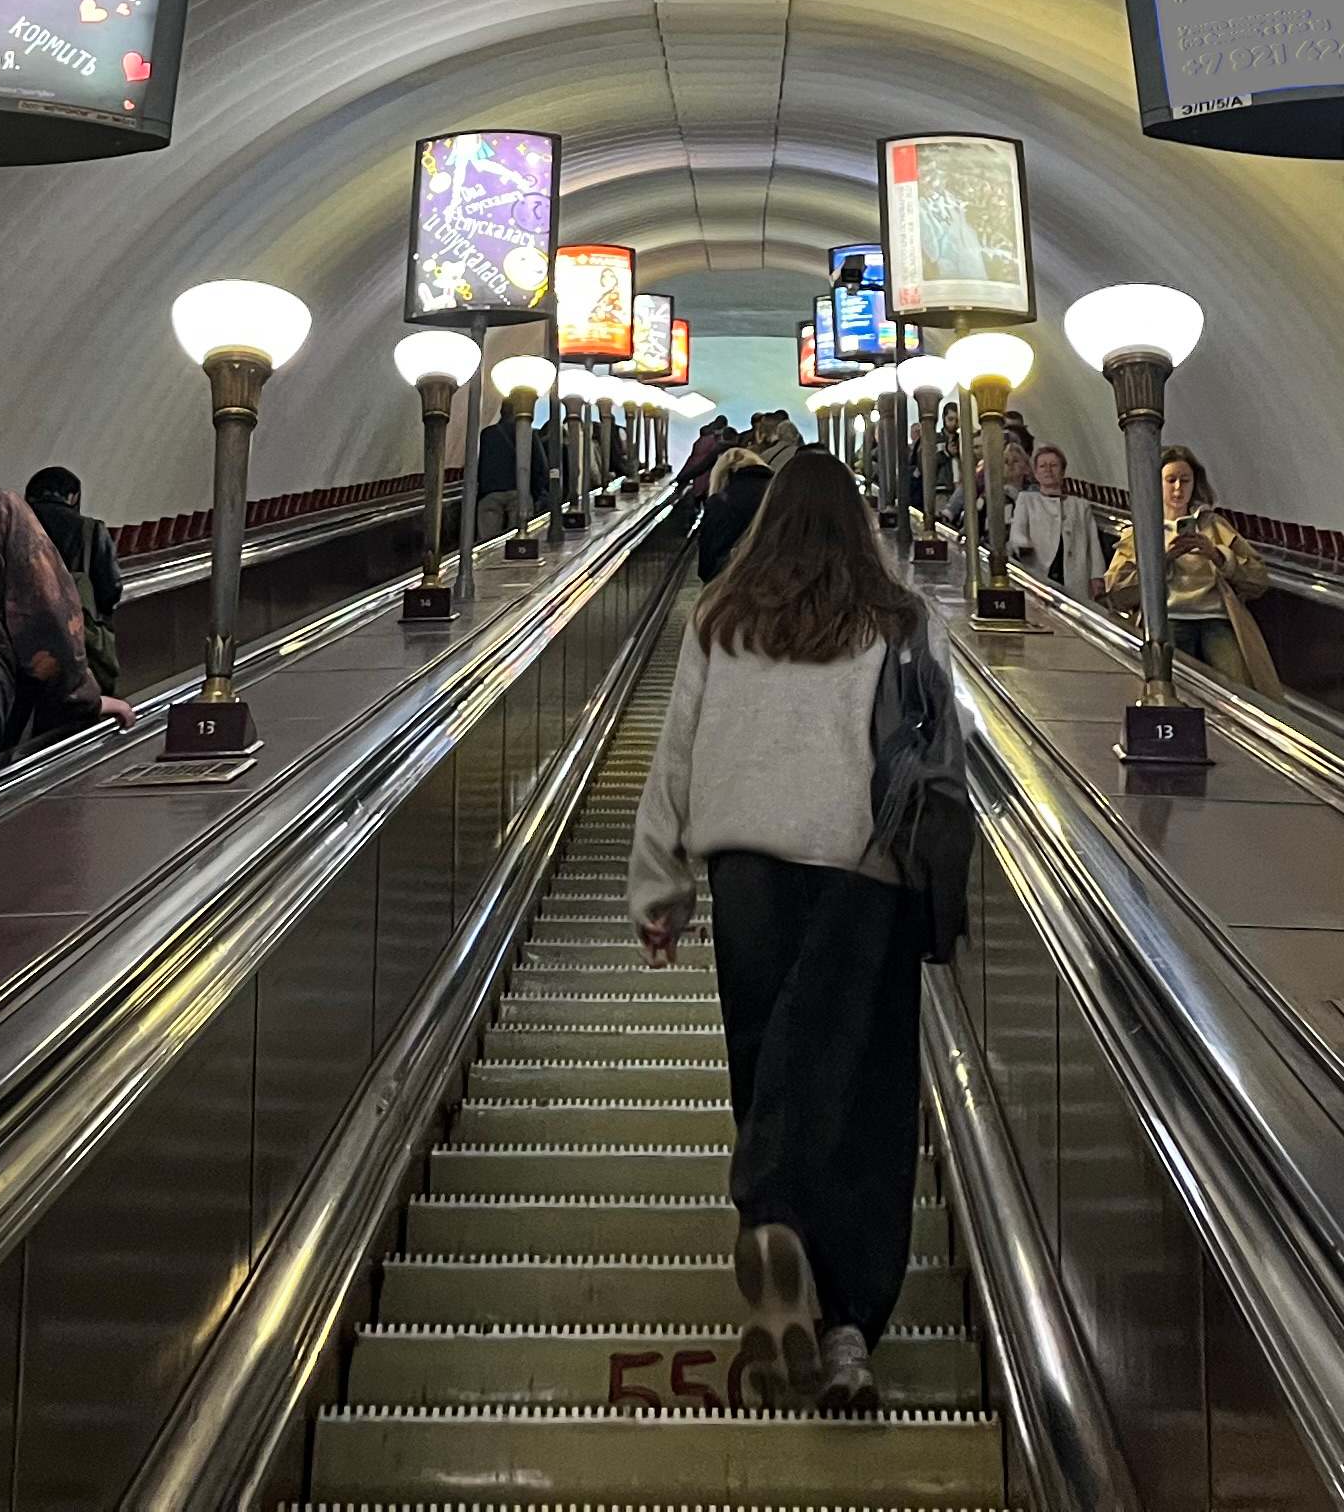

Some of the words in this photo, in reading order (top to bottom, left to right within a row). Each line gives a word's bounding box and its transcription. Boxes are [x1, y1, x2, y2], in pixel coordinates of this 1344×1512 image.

[7, 15, 99, 77] кормить
[197, 720, 216, 735] 13
[1156, 724, 1174, 739] 13
